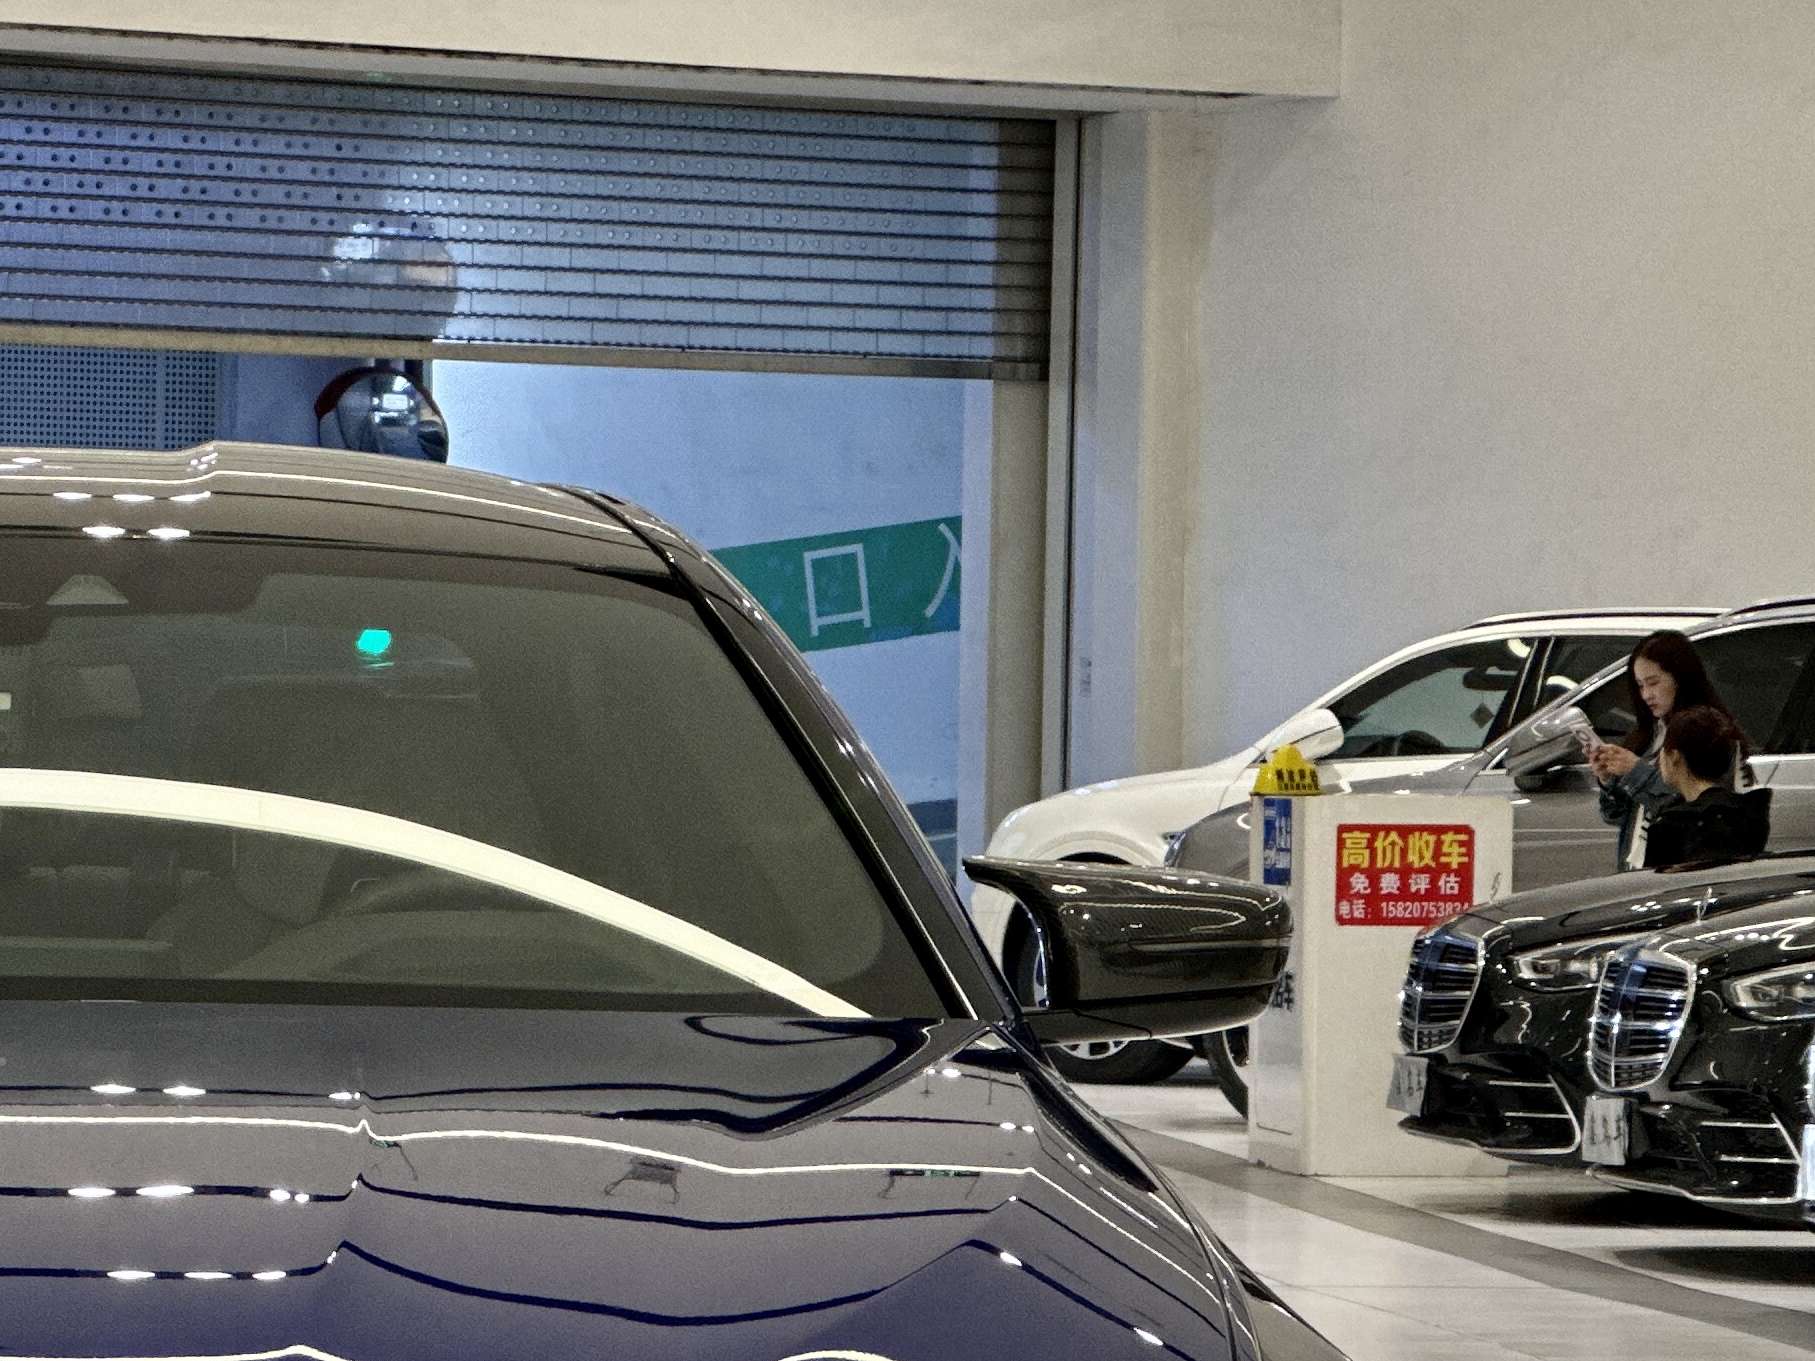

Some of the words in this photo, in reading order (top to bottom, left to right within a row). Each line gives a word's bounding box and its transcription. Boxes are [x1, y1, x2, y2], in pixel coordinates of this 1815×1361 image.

[1340, 831, 1470, 869] 高价收车
[1349, 873, 1461, 895] 免费评估
